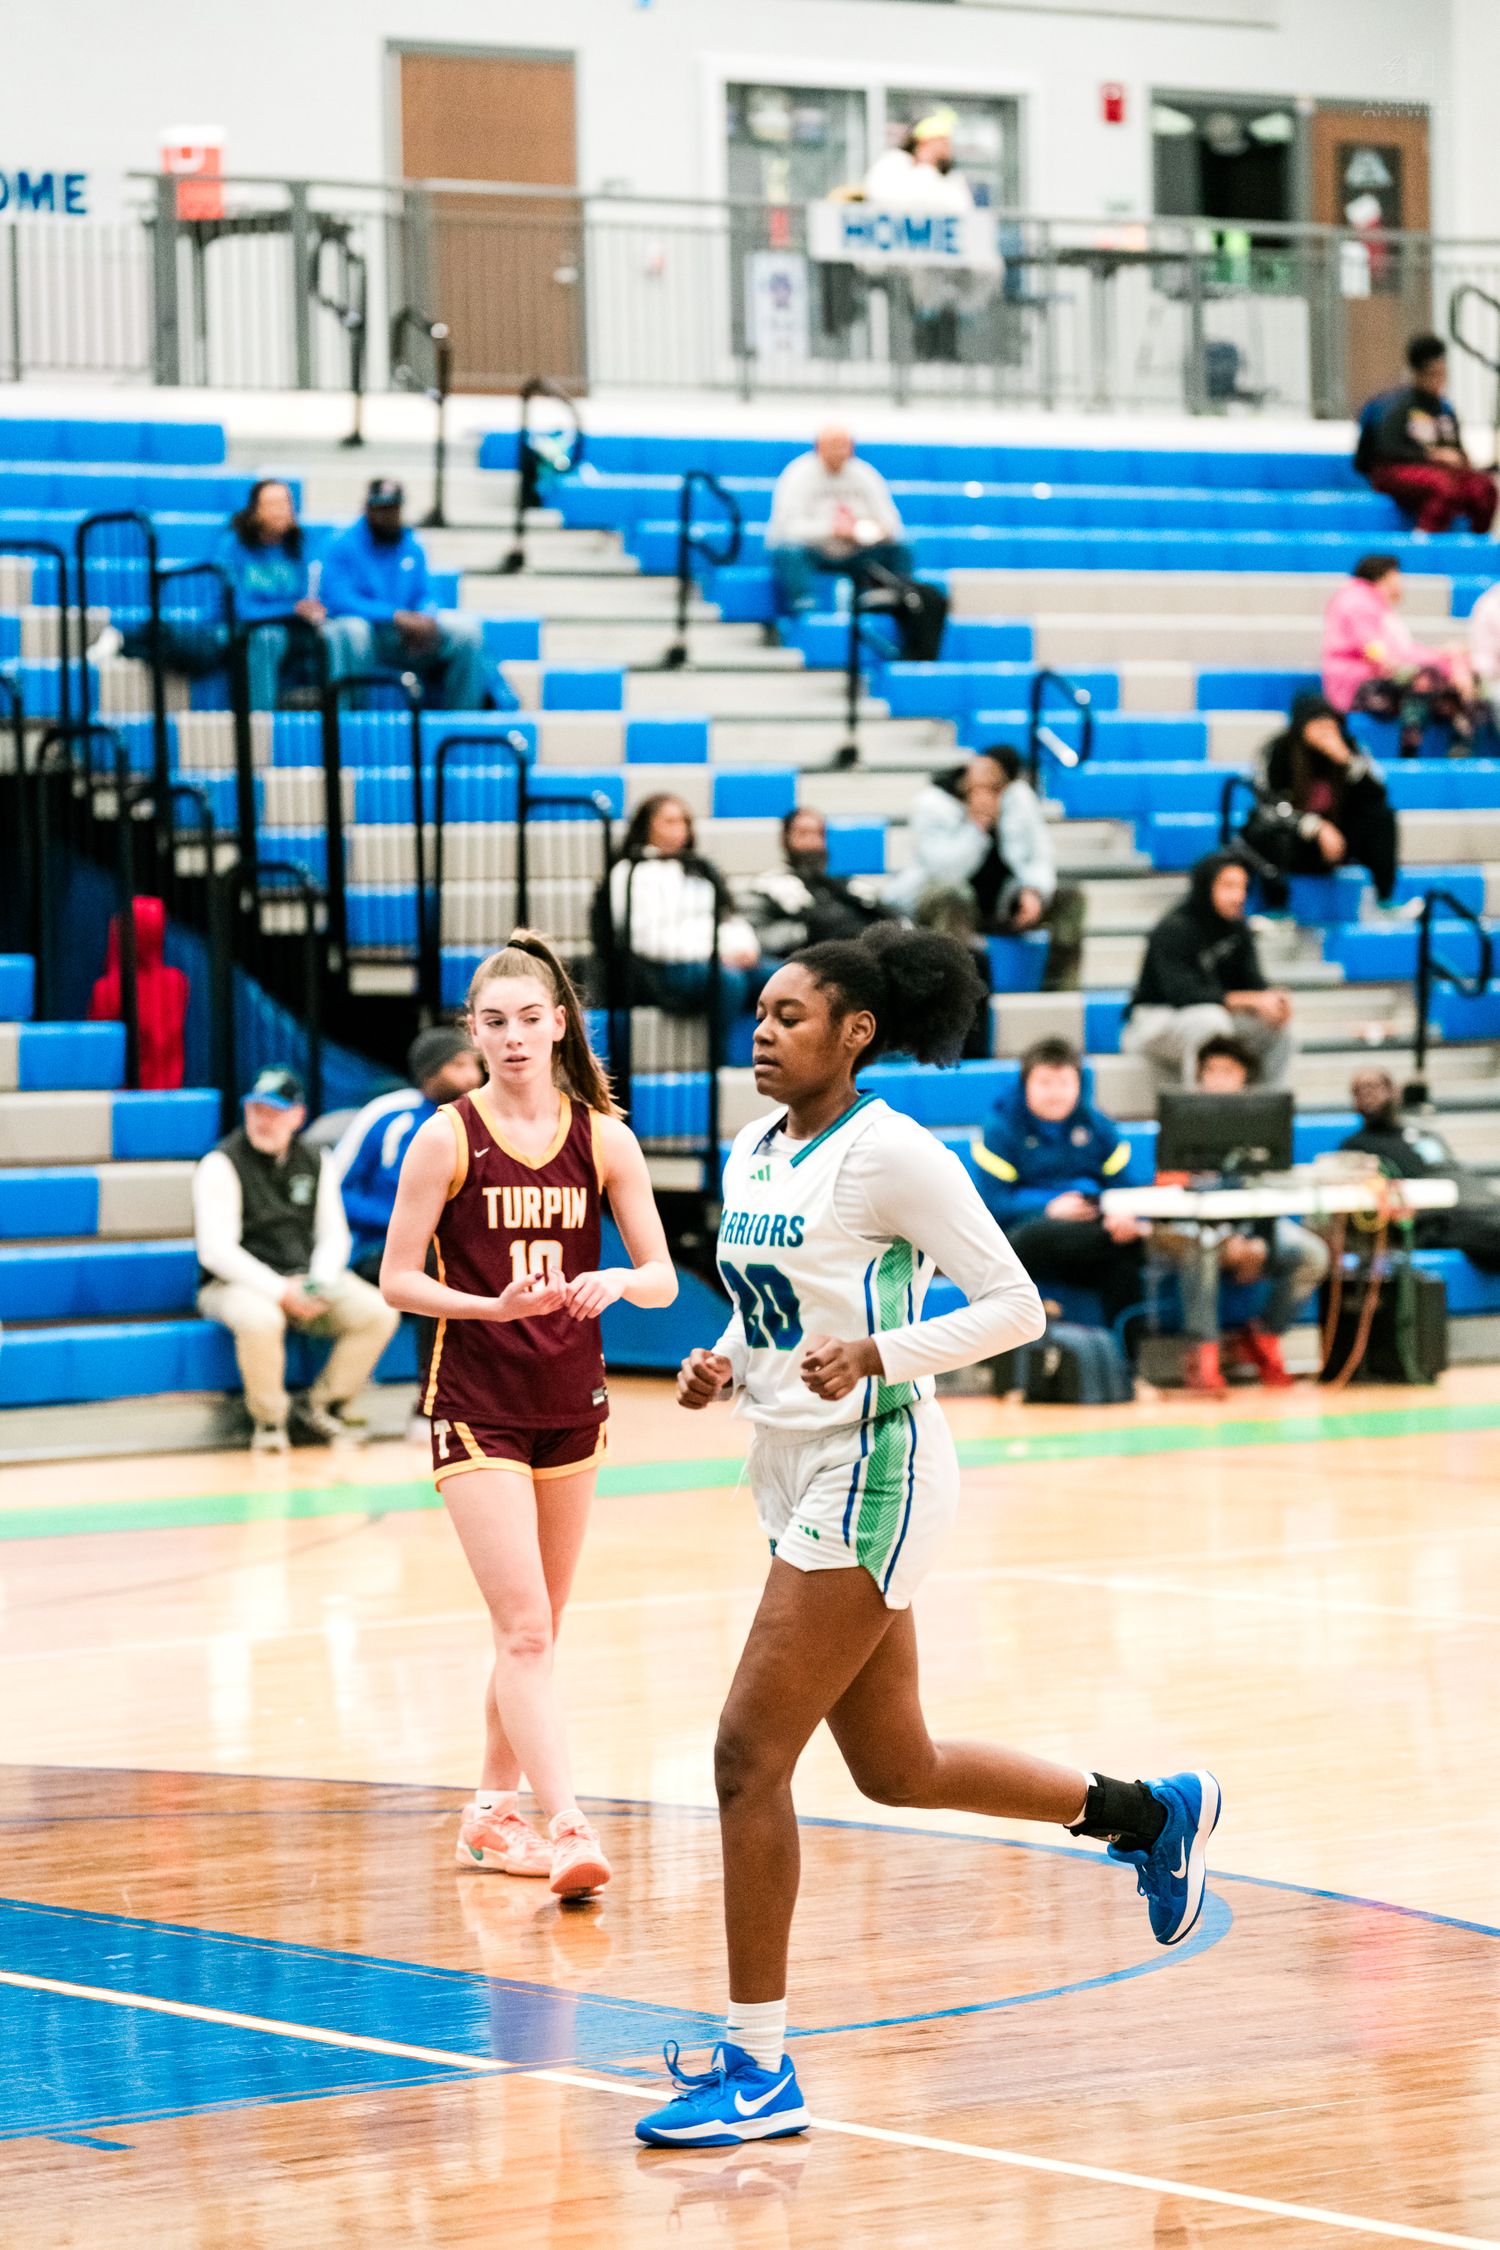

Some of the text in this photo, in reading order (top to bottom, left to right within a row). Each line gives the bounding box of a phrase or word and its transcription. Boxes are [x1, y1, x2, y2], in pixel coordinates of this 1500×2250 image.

[843, 213, 960, 254] HOME
[482, 1186, 588, 1229] TURPIN
[509, 1239, 564, 1294] 10
[719, 1260, 804, 1351] 20
